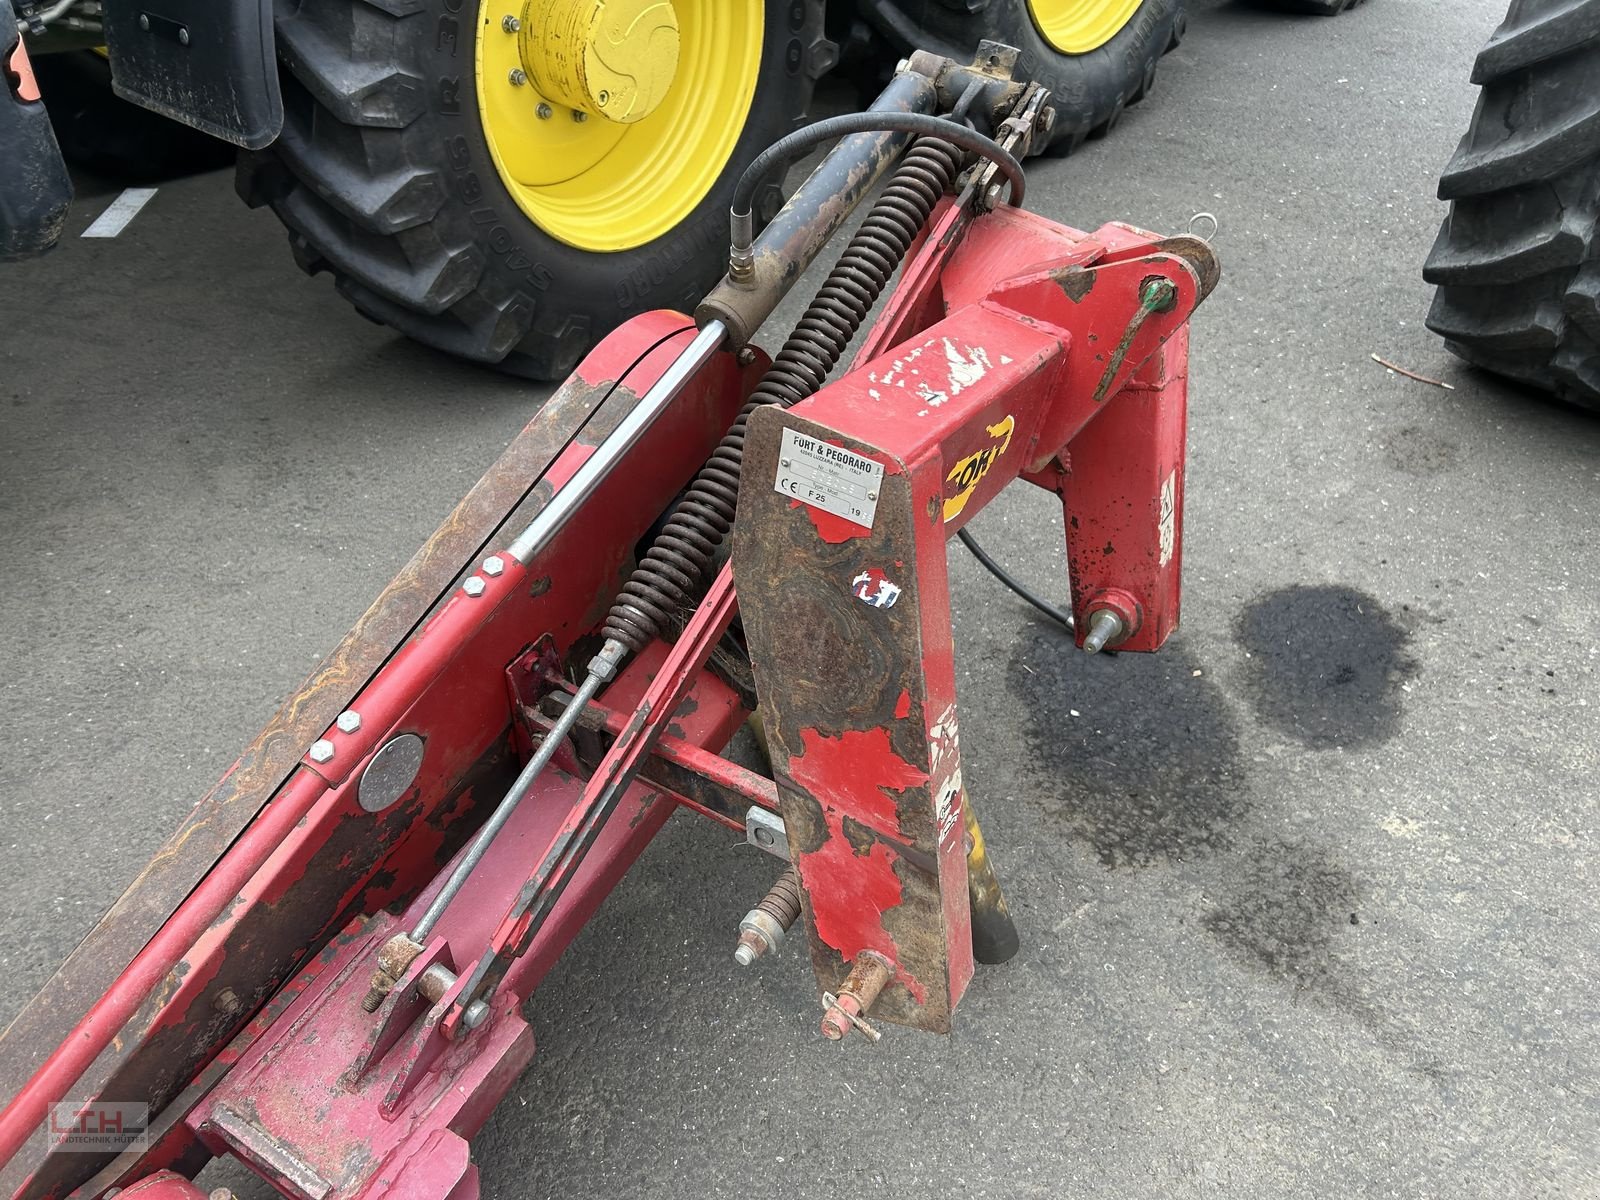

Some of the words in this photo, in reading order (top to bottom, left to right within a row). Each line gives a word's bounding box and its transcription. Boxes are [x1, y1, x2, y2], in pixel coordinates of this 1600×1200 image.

[812, 453, 834, 465] LUZZARA
[849, 468, 862, 476] ITALY
[816, 445, 824, 456] &
[825, 448, 872, 473] PEGORARO
[815, 493, 826, 503] 25
